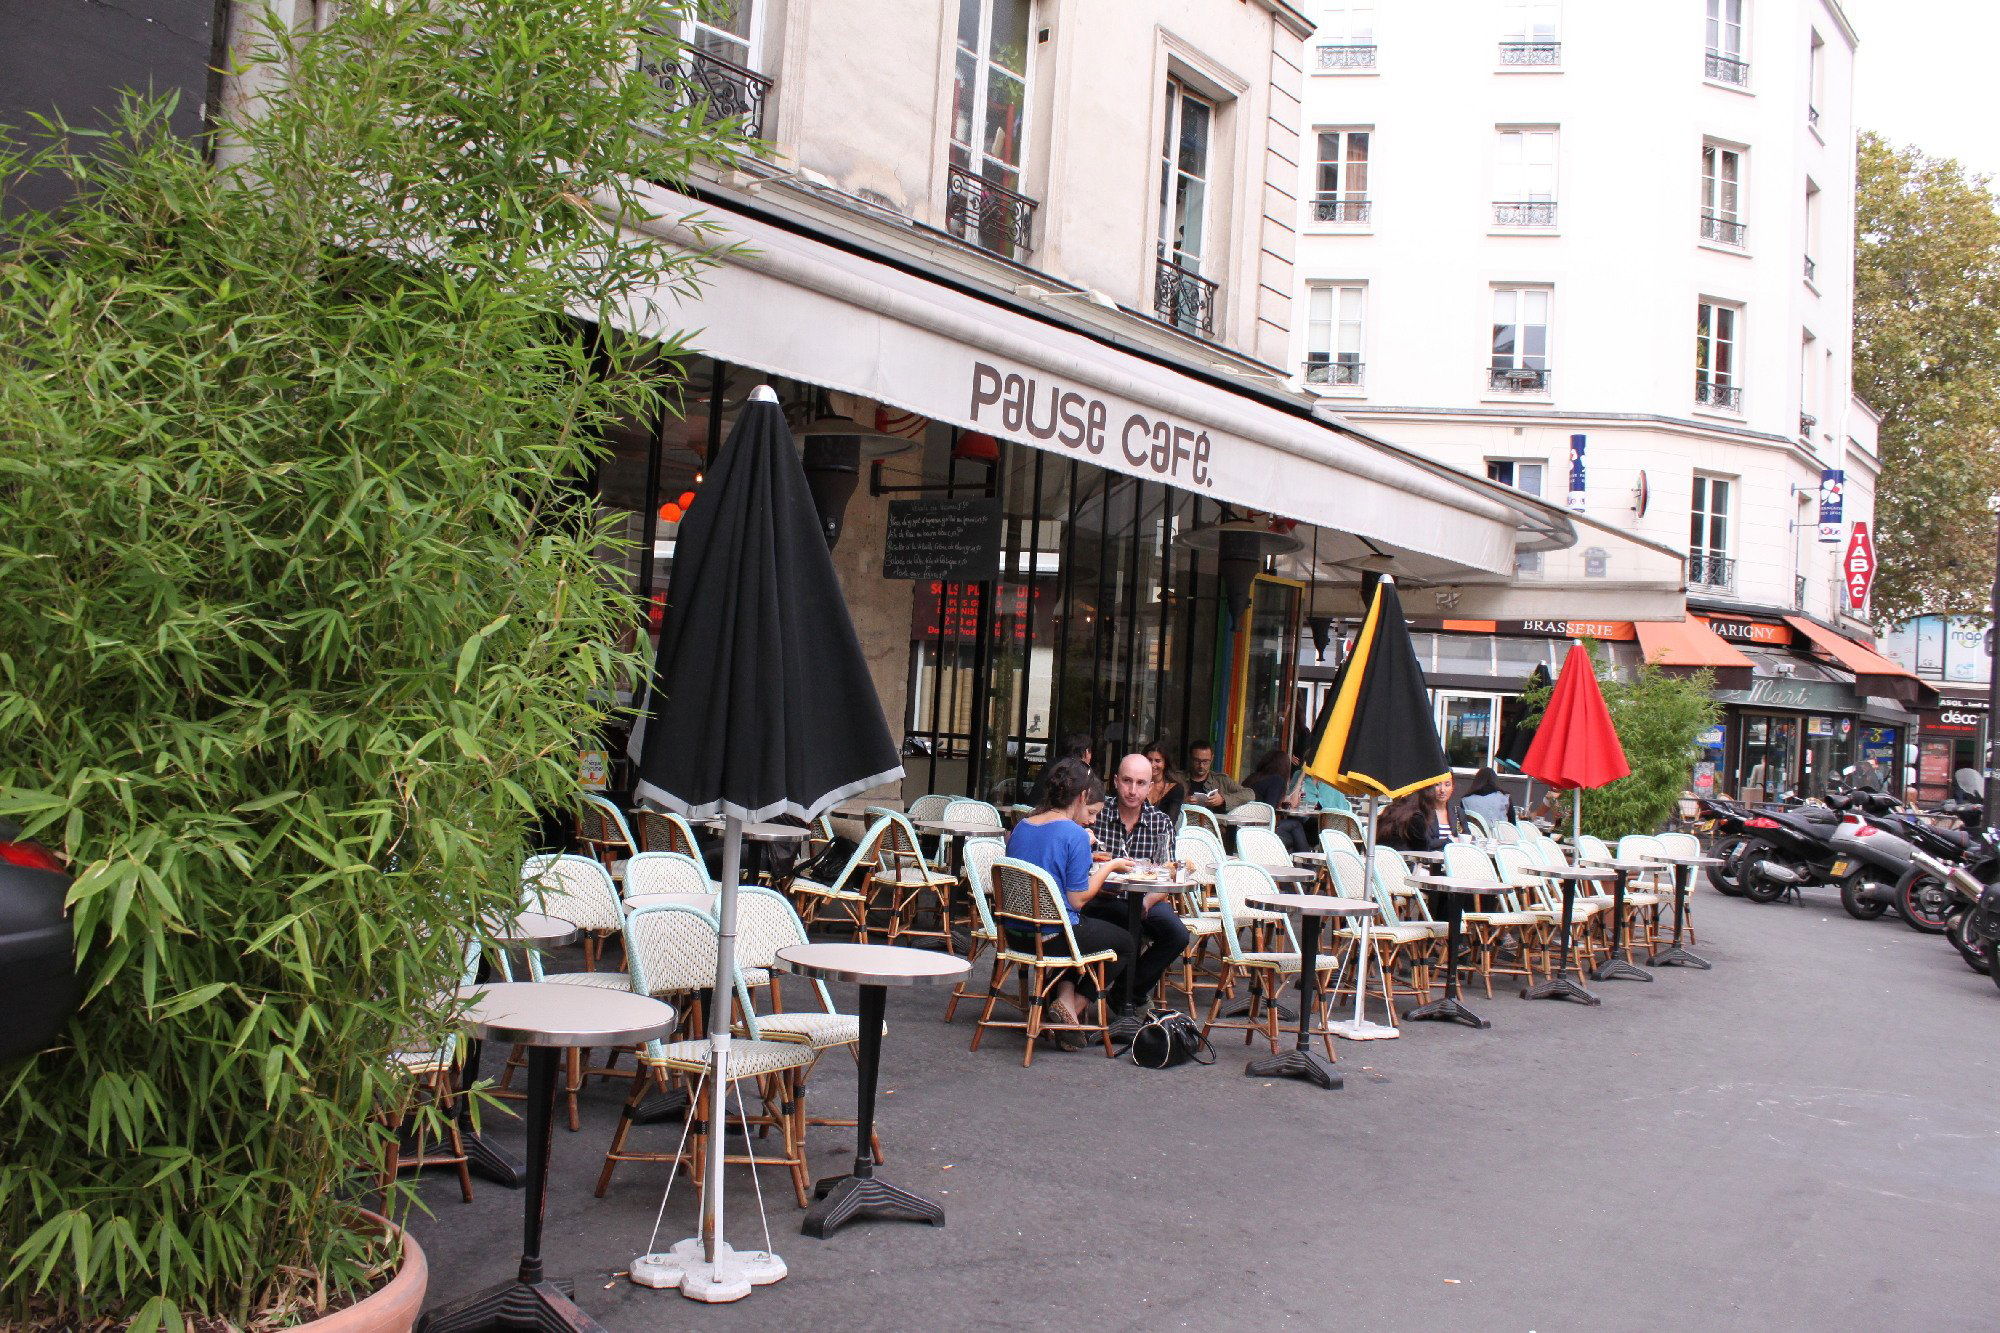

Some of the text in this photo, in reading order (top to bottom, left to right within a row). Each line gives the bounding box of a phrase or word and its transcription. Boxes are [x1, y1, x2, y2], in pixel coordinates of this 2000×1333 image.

[1850, 533, 1869, 598] TABAC
[1523, 620, 1613, 637] BRASSERIE
[1708, 622, 1776, 639] MARIGNY
[1951, 630, 1983, 645] map
